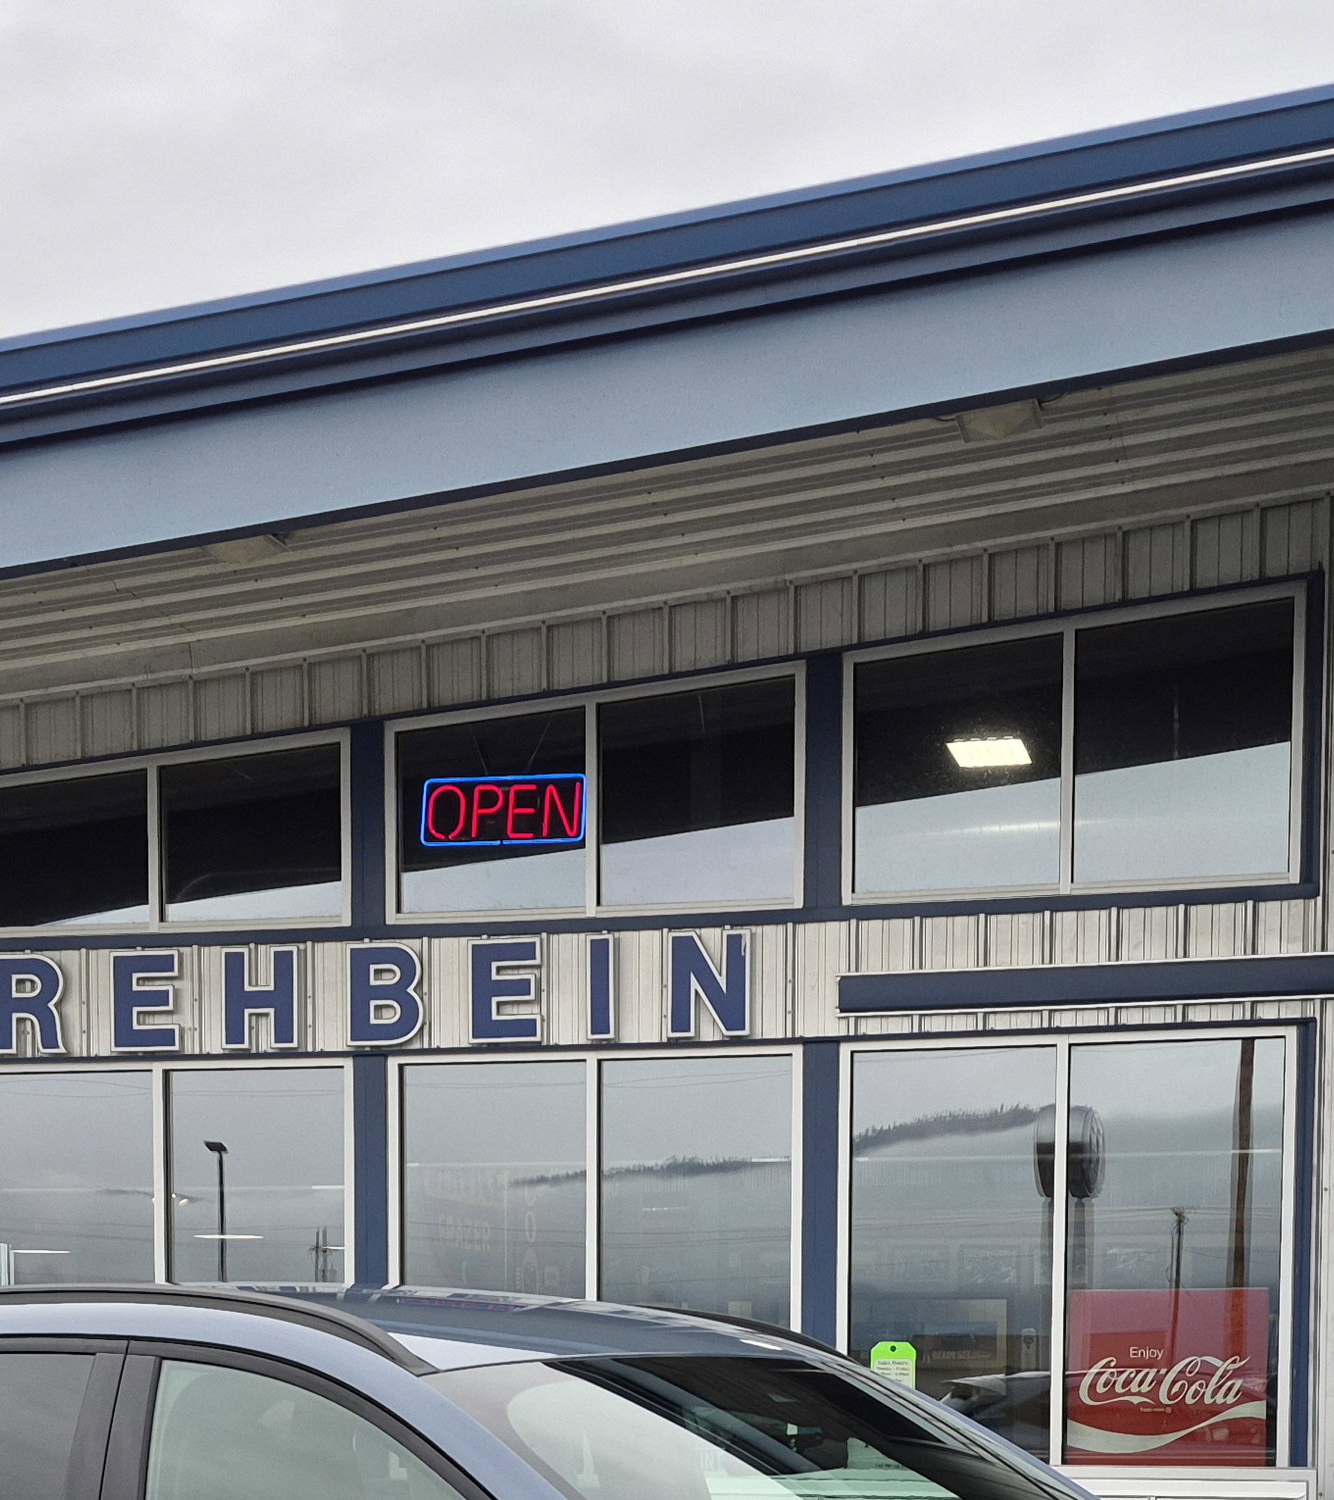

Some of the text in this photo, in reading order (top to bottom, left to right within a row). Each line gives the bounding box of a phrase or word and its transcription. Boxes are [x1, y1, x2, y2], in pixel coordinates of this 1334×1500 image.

[427, 782, 581, 840] OPEN
[1129, 1346, 1164, 1360] Enjoy
[1079, 1355, 1252, 1406] Coca-Cola
